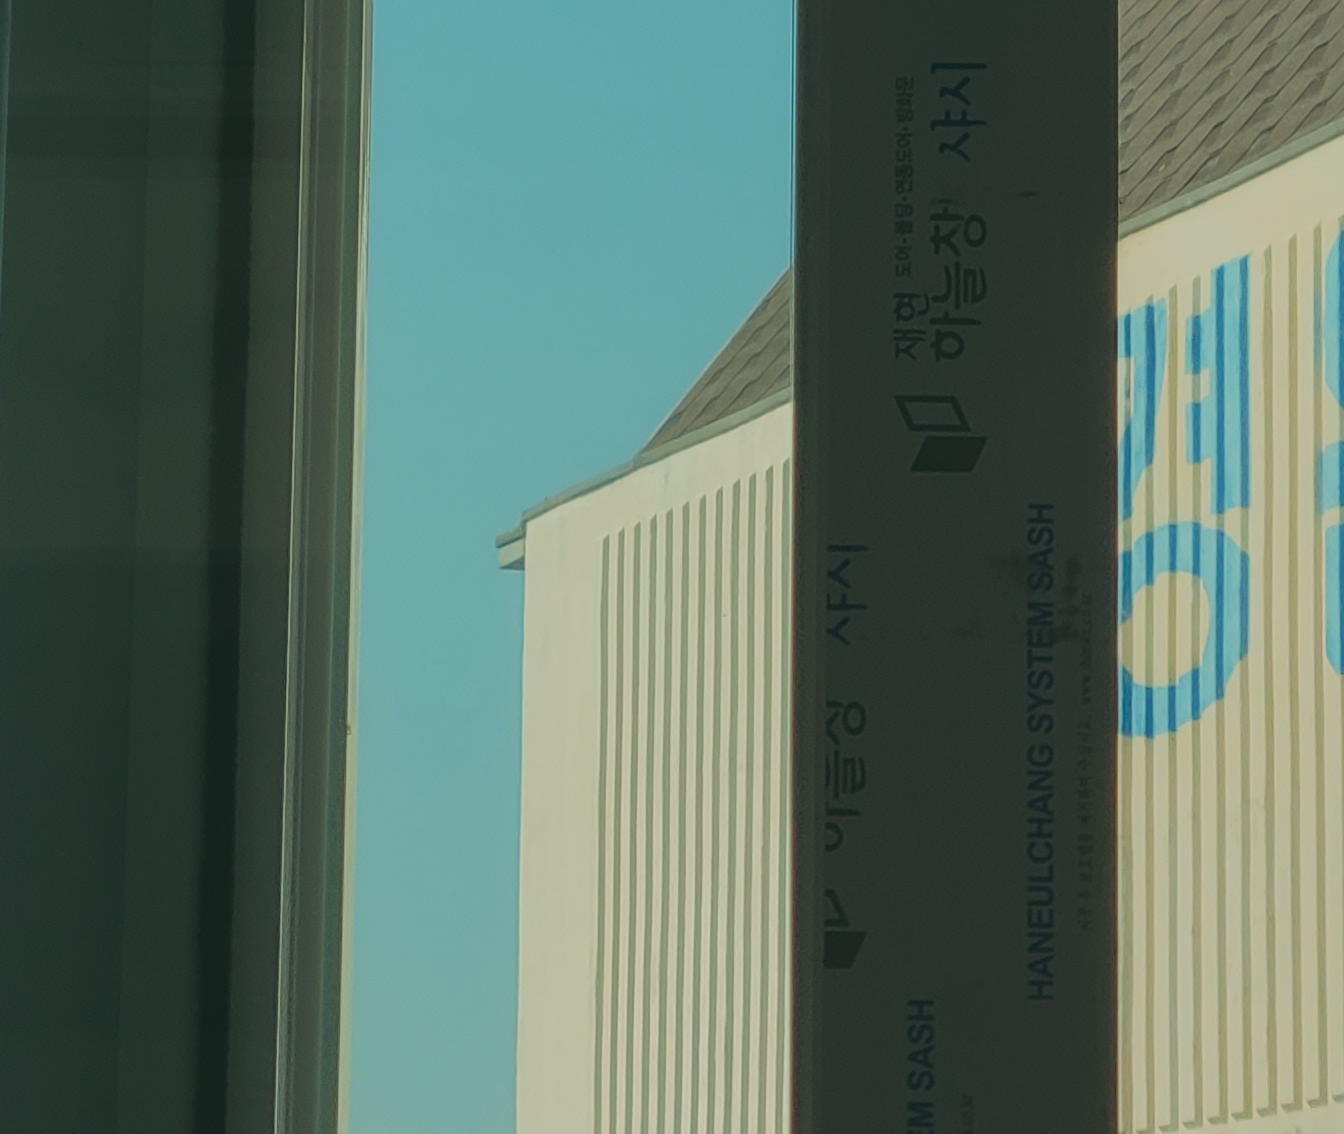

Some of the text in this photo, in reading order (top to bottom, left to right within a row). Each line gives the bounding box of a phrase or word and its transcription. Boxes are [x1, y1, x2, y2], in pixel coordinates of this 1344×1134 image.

[928, 62, 990, 363] 하늘창 샤시
[891, 291, 931, 362] 재현
[1026, 502, 1055, 1001] HANEULCHANG SYSTEM SASH
[905, 998, 936, 1092] SASH
